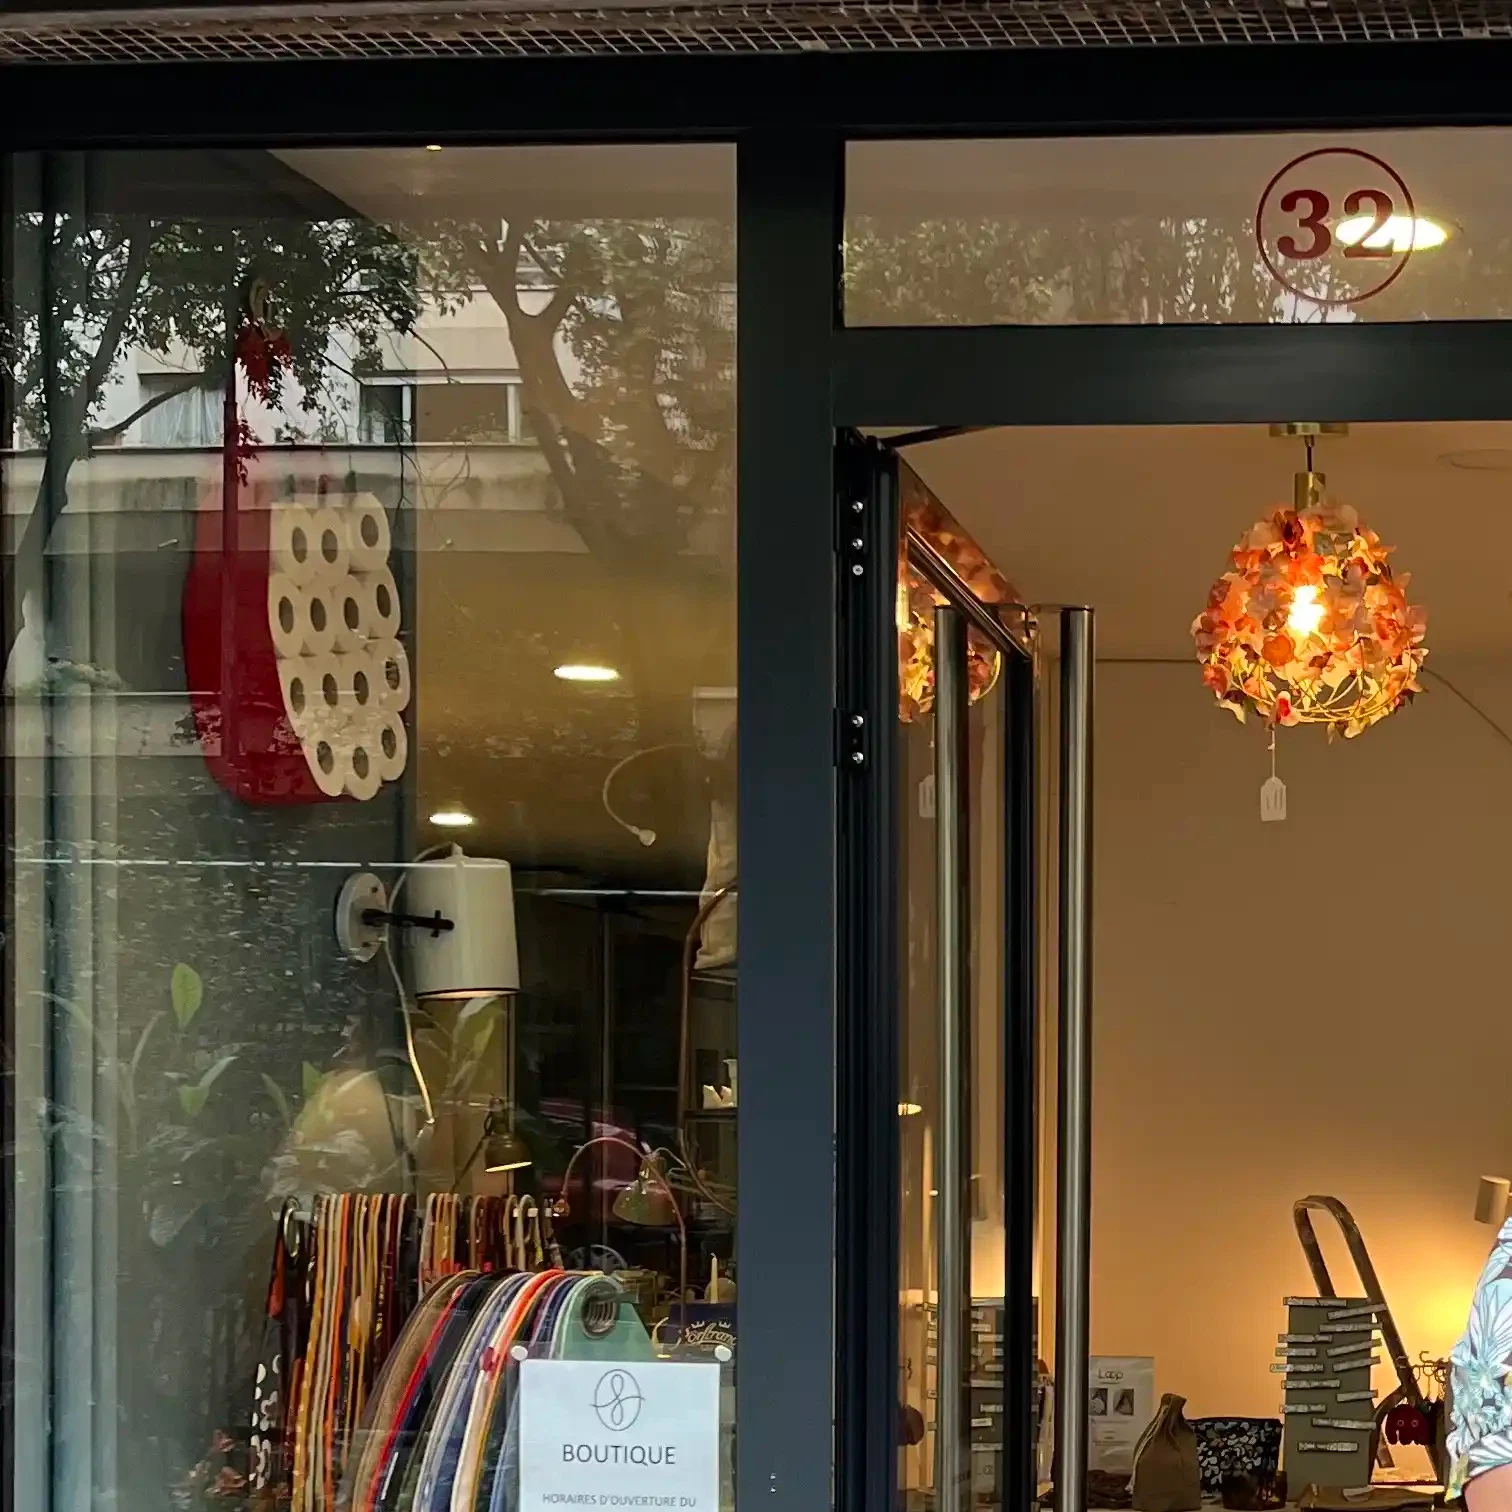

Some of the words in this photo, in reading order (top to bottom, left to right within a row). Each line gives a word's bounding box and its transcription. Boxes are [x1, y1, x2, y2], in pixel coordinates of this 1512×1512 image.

[1277, 188, 1394, 260] 32
[562, 1444, 676, 1466] BOUTIQUE
[542, 1493, 596, 1505] HORAIRES
[600, 1494, 676, 1506] D'OUVERTURE
[680, 1497, 697, 1507] DU
